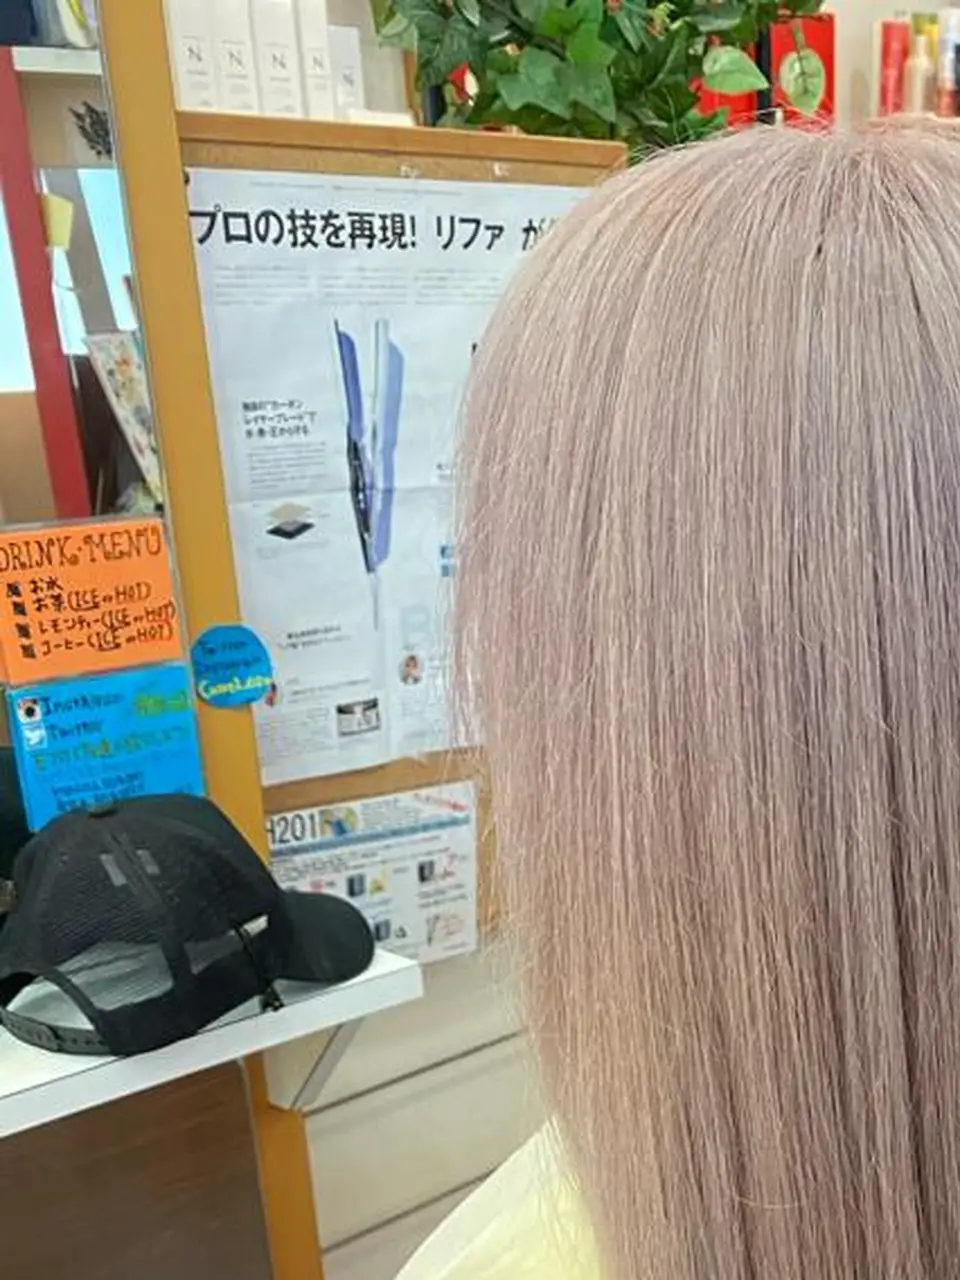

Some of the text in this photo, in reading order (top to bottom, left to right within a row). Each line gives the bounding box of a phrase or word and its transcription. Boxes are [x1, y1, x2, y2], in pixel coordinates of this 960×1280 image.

[188, 203, 417, 249] プロの技を再現!
[435, 214, 505, 250] リファ
[82, 523, 164, 564] MENU
